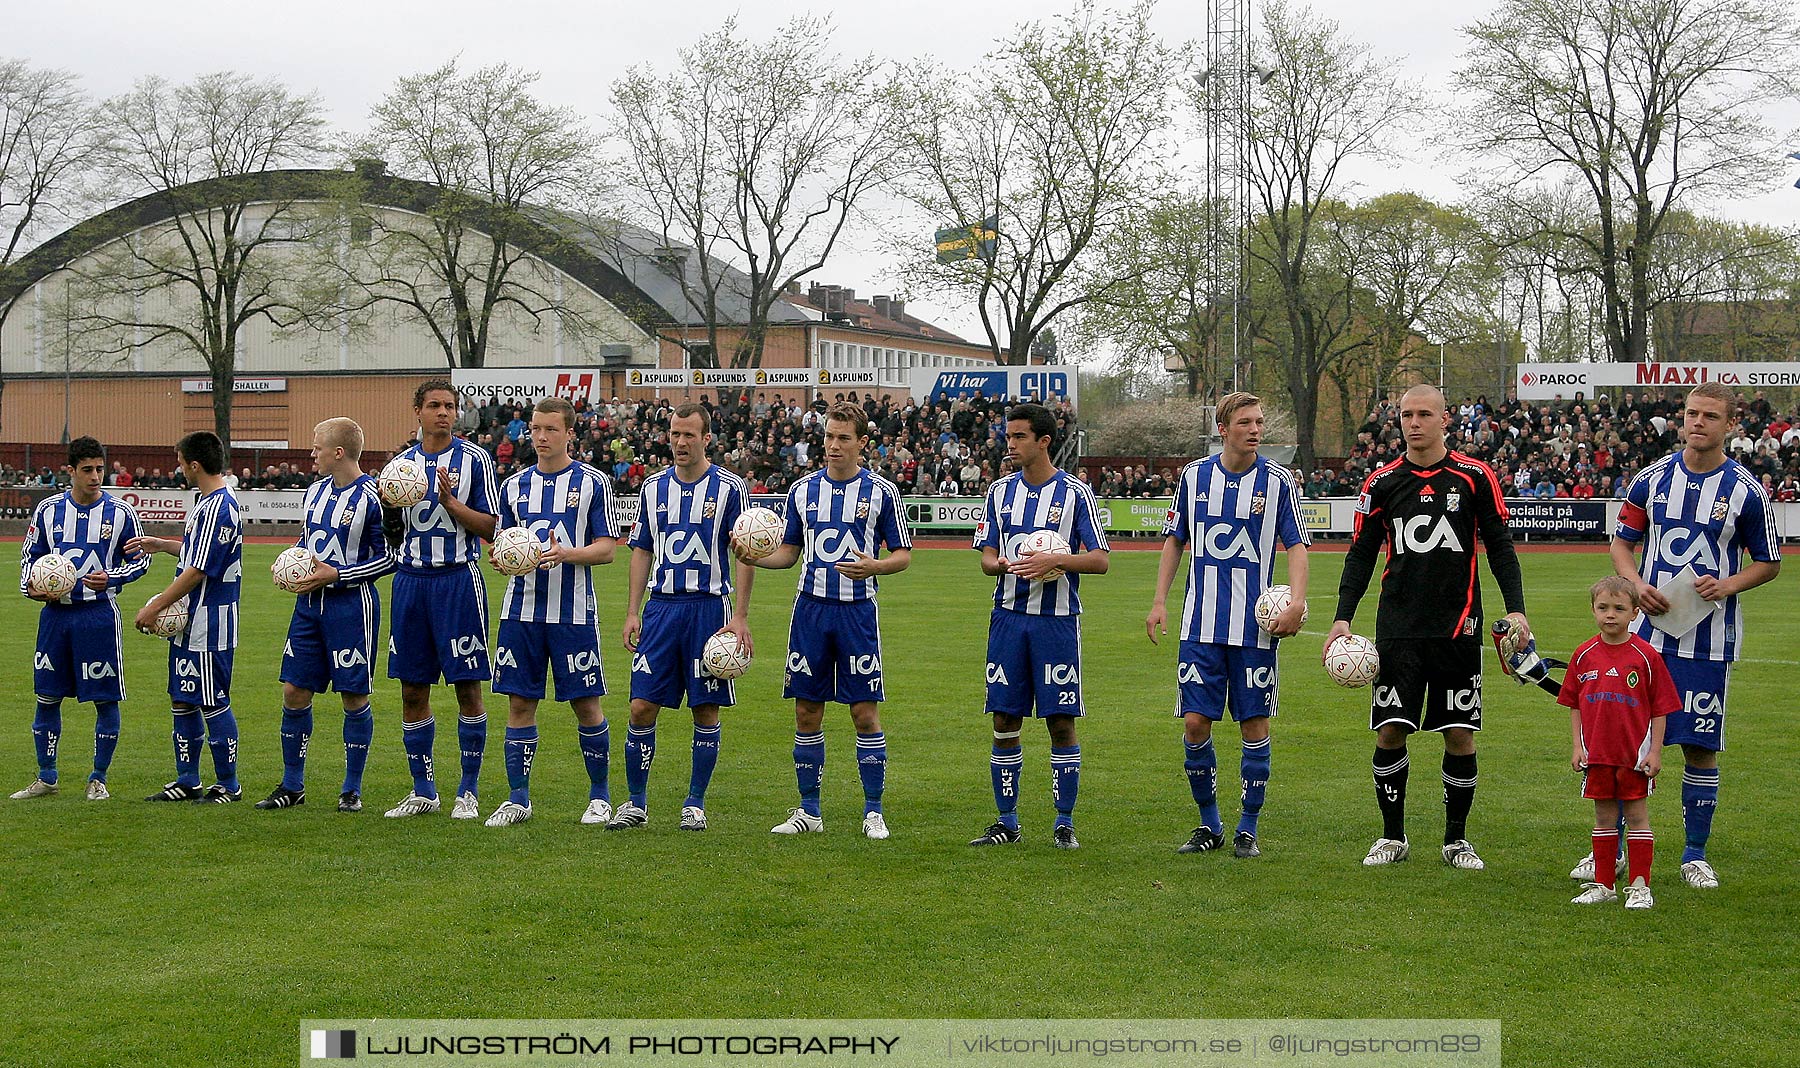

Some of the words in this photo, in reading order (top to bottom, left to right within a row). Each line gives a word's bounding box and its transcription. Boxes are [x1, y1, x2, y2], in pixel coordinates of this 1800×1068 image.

[644, 374, 684, 383] ASPLUNDS
[707, 374, 747, 383] ASPLUNDS
[769, 373, 809, 382] ASPLUNDS
[832, 373, 874, 382] ASPLUNDS
[940, 374, 958, 388] Vi
[959, 374, 989, 388] har
[1539, 374, 1587, 385] PAROC
[1636, 363, 1708, 385] MAXI
[1717, 373, 1741, 385] ICA
[457, 382, 546, 397] KÖKSFORUM
[1687, 482, 1700, 490] ICA
[122, 493, 184, 508] OFFICE
[138, 511, 183, 520] Center
[1557, 505, 1573, 518] på
[1506, 518, 1599, 531] abbkopplingar
[1392, 514, 1464, 555] ICA
[659, 530, 712, 565] ICA
[806, 528, 862, 563] ICA
[1195, 522, 1260, 564] ICA
[1654, 525, 1719, 571] ICA
[54, 548, 104, 580] CA
[451, 635, 485, 658] ICA
[332, 648, 367, 669] ICA
[464, 656, 478, 670] 11
[566, 650, 600, 673] ICA
[850, 654, 880, 675] ICA
[82, 661, 117, 680] ICA
[176, 658, 200, 678] ICA
[1044, 664, 1079, 685] ICA
[582, 672, 597, 688] 15
[1246, 666, 1276, 688] ICA
[1470, 674, 1482, 689] 12
[180, 680, 196, 692] 20
[704, 679, 719, 693] 14
[868, 678, 880, 692] 17
[1058, 691, 1076, 705] 23
[1446, 689, 1482, 711] ICA
[1683, 690, 1723, 716] ICA
[1694, 718, 1716, 733] 22
